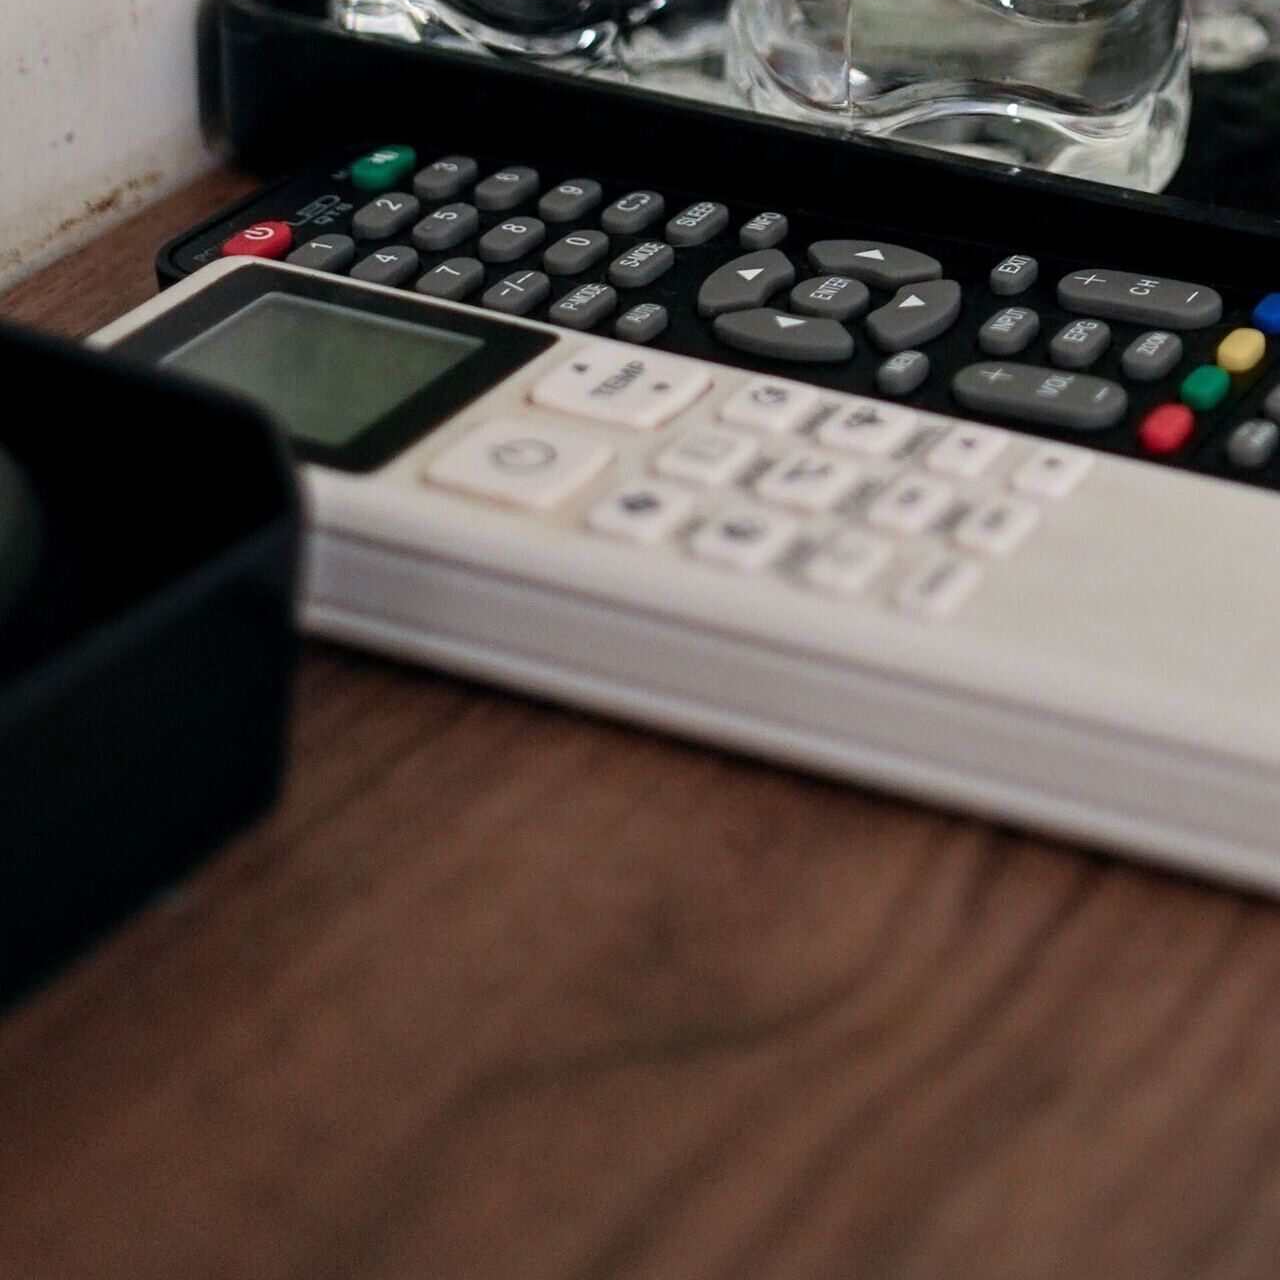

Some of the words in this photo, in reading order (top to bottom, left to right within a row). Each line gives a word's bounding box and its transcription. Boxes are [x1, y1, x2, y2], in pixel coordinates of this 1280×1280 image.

[375, 198, 403, 212] 2
[433, 209, 458, 222] 5
[501, 222, 528, 234] 8
[746, 211, 782, 233] INFO
[310, 241, 334, 250] 1
[374, 251, 399, 264] 4
[997, 253, 1033, 275] EXIT
[434, 265, 462, 277] 7
[559, 283, 609, 312] P-MODE
[808, 276, 853, 301] ENTER
[1128, 278, 1160, 297] CH
[624, 302, 662, 323] AUTO
[989, 307, 1029, 333] INPUT
[1062, 318, 1100, 344] EPG
[1135, 330, 1172, 357] ZOOM
[590, 359, 647, 397] TEMP
[1036, 373, 1076, 397] VOL
